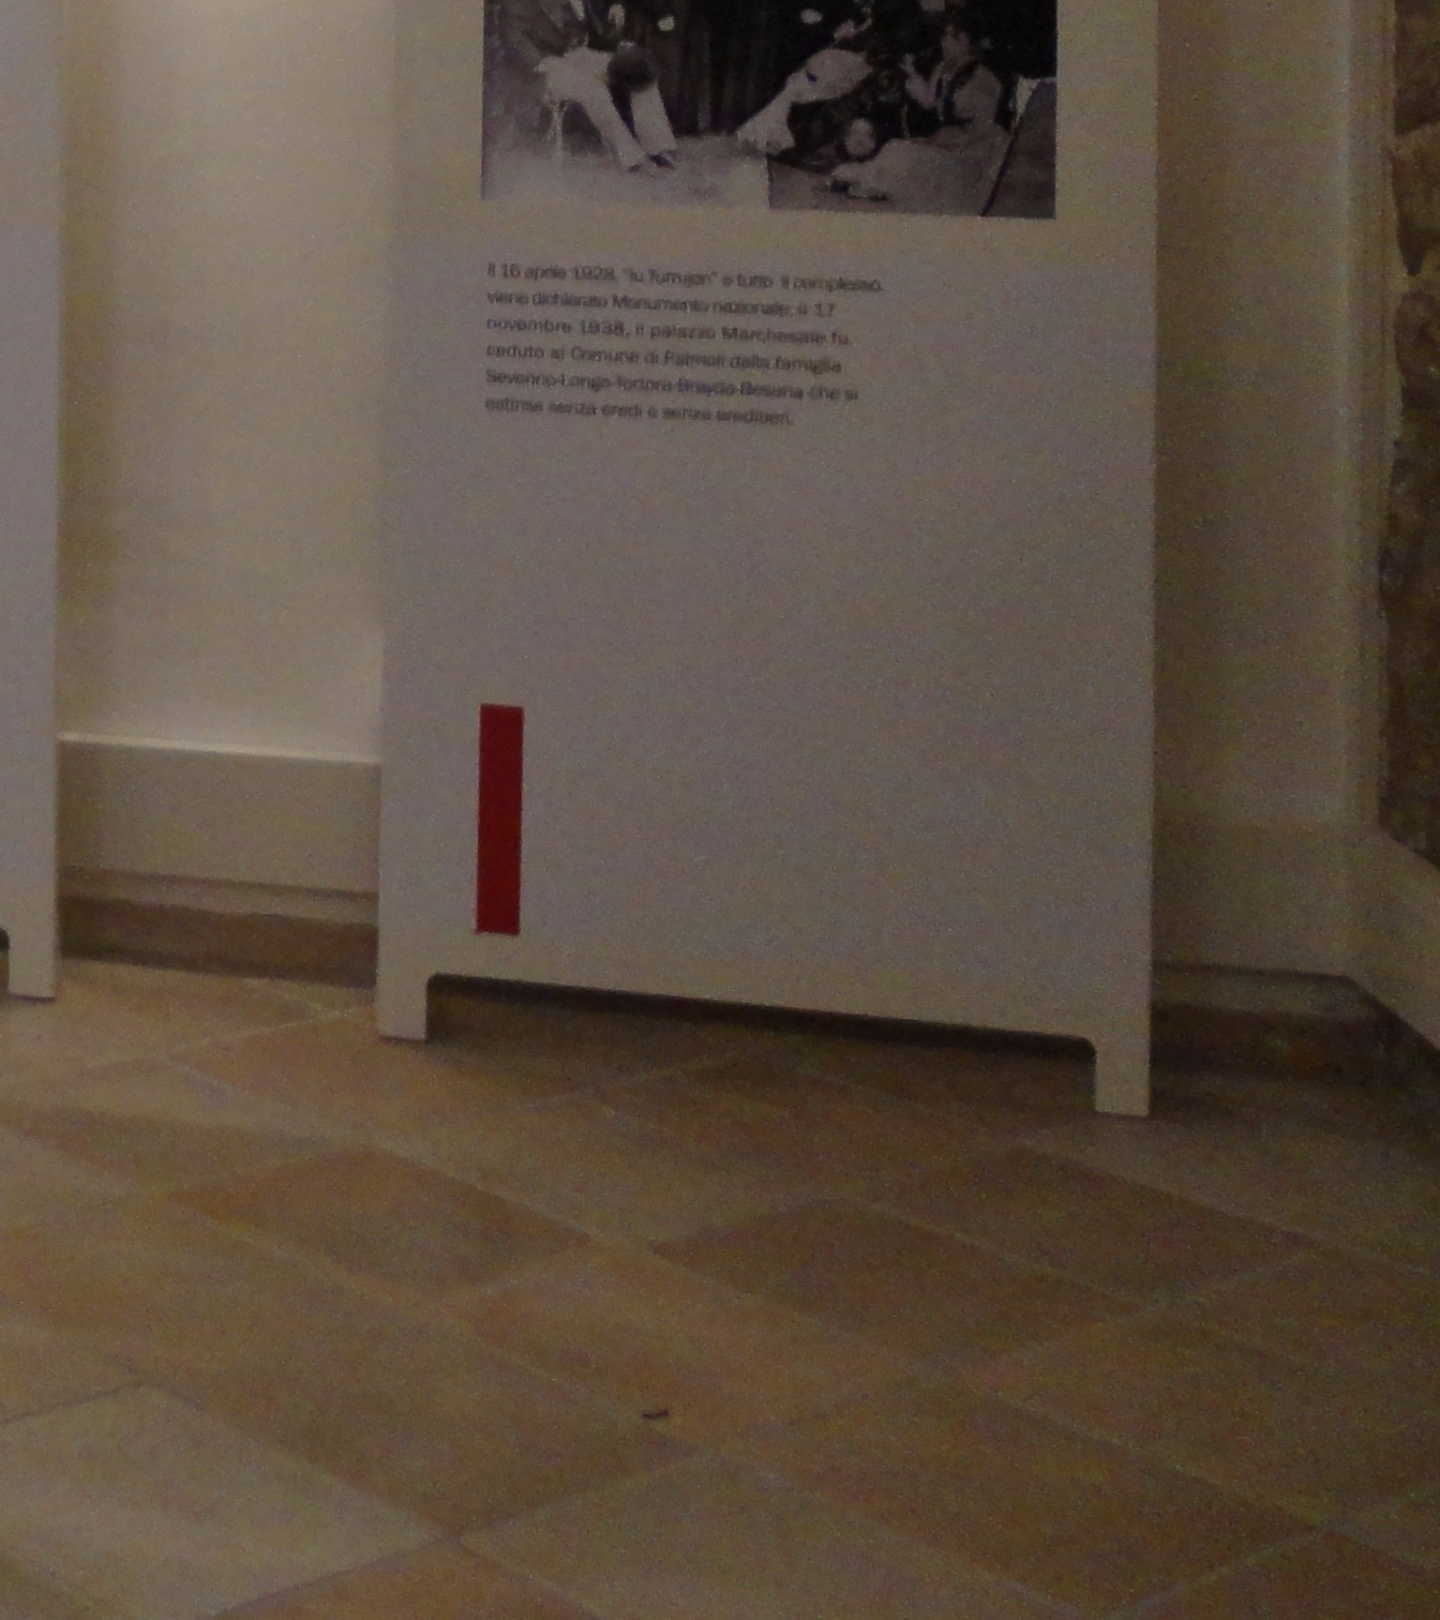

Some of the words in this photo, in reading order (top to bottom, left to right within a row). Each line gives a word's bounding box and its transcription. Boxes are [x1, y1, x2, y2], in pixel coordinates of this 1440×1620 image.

[501, 263, 520, 277] 16
[533, 290, 607, 308] dichiarato
[613, 294, 709, 312] Monumento
[815, 302, 835, 317] 17
[487, 318, 571, 333] novembre
[487, 343, 544, 359] ceduto
[571, 346, 638, 363] Comune
[645, 349, 658, 364] di
